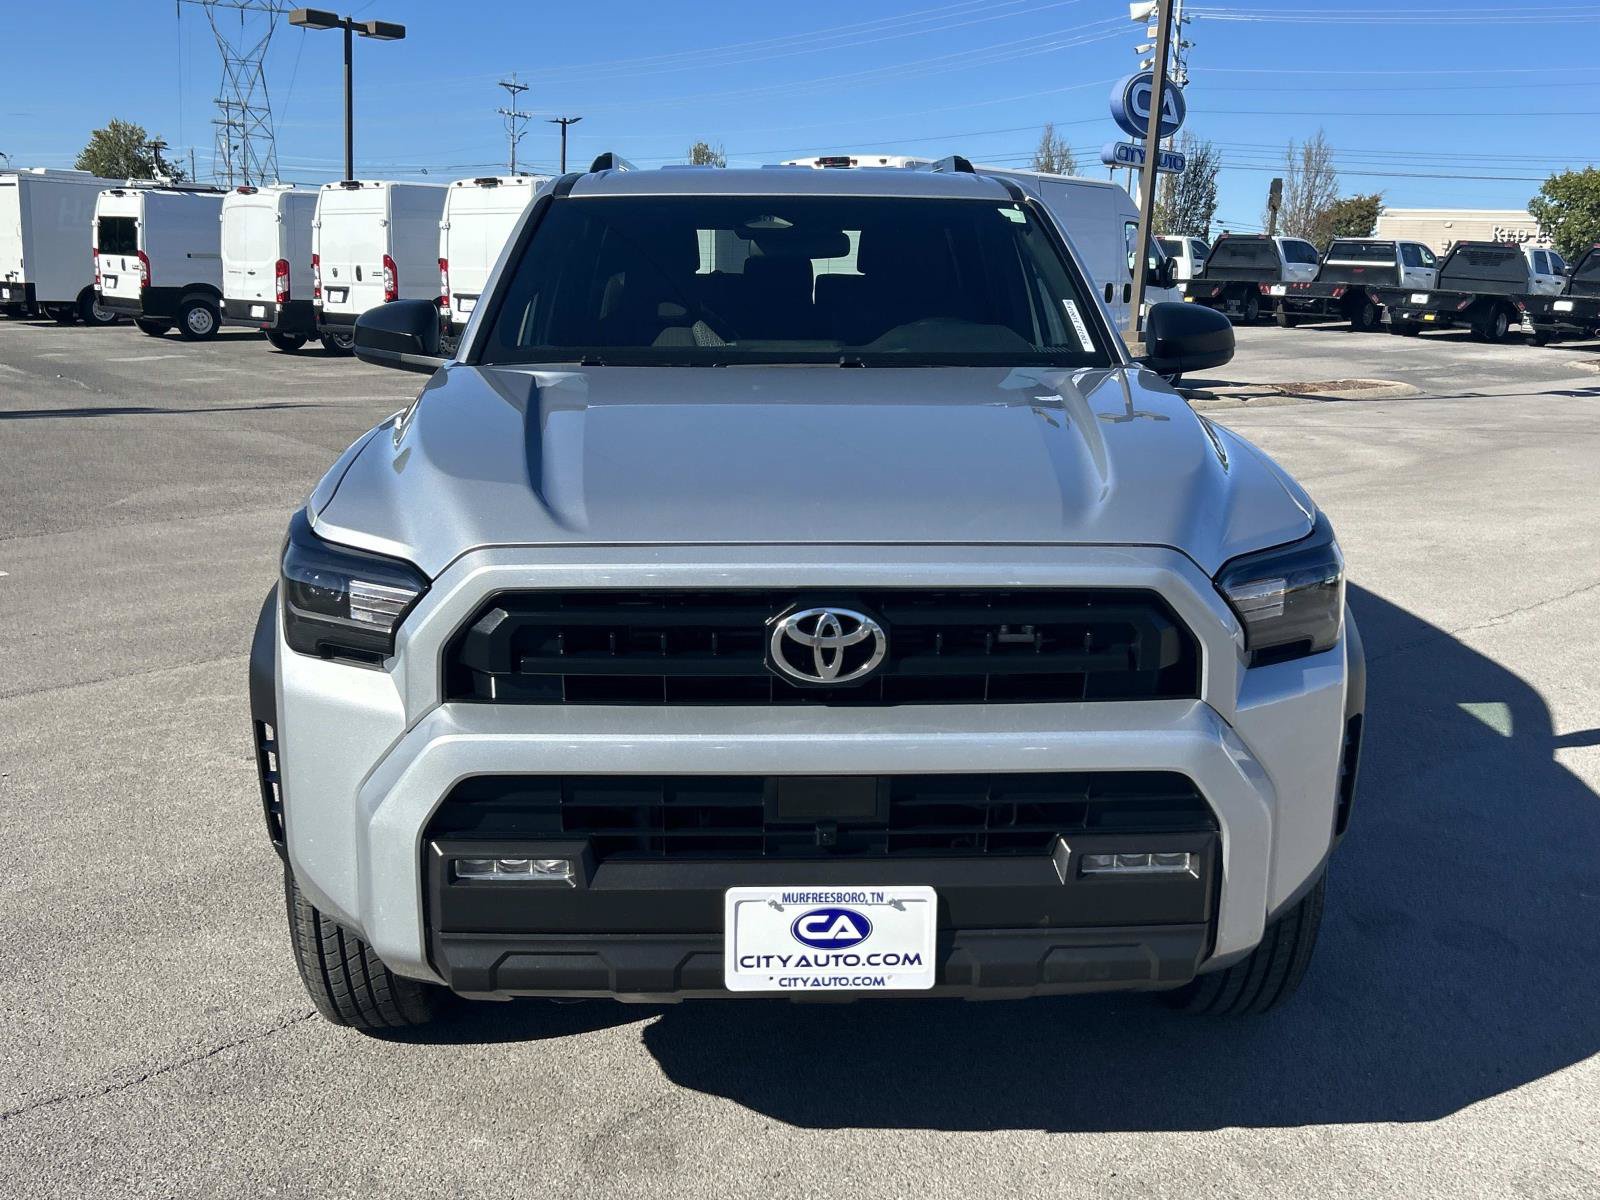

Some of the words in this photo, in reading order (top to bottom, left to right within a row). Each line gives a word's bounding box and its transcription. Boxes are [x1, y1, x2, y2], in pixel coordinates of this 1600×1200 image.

[782, 892, 868, 904] MURFREESBORO,
[870, 892, 884, 903] TN
[798, 914, 863, 940] CA
[739, 952, 922, 968] CITYAUTO.COM
[778, 976, 885, 987] CITYAUTO.COM
